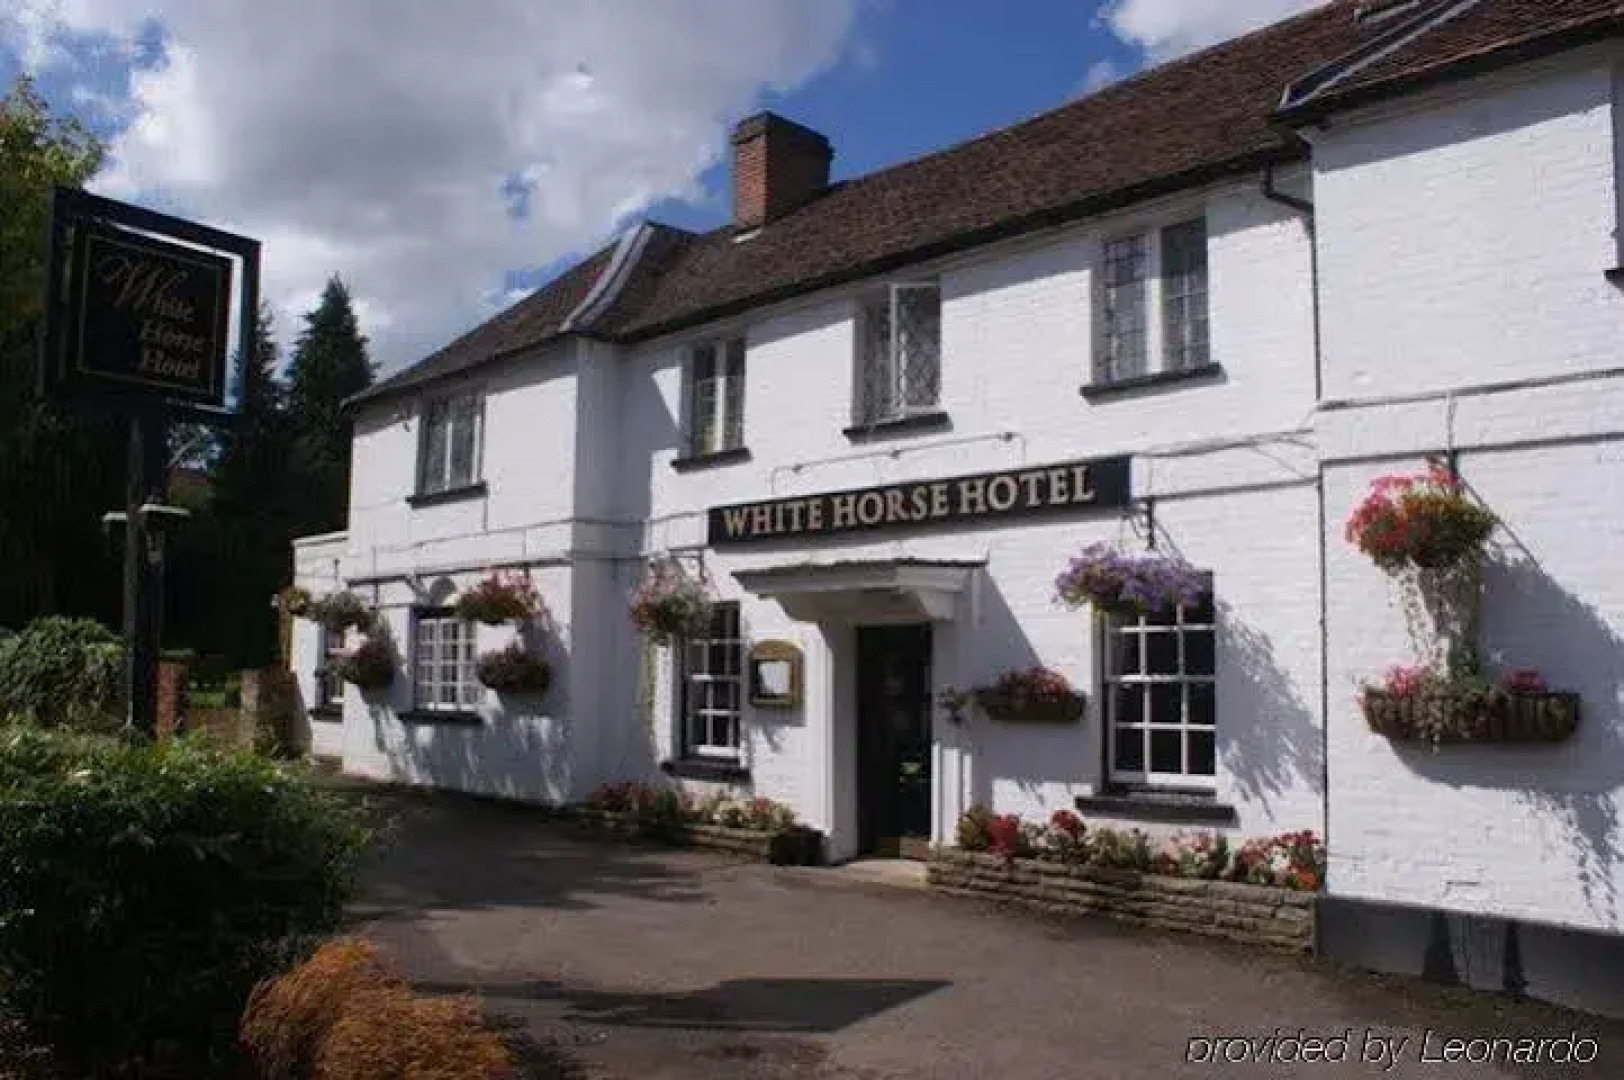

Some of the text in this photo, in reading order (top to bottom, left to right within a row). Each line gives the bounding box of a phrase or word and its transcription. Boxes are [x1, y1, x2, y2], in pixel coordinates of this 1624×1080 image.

[723, 466, 1095, 537] WHITE HORSE HOTEL
